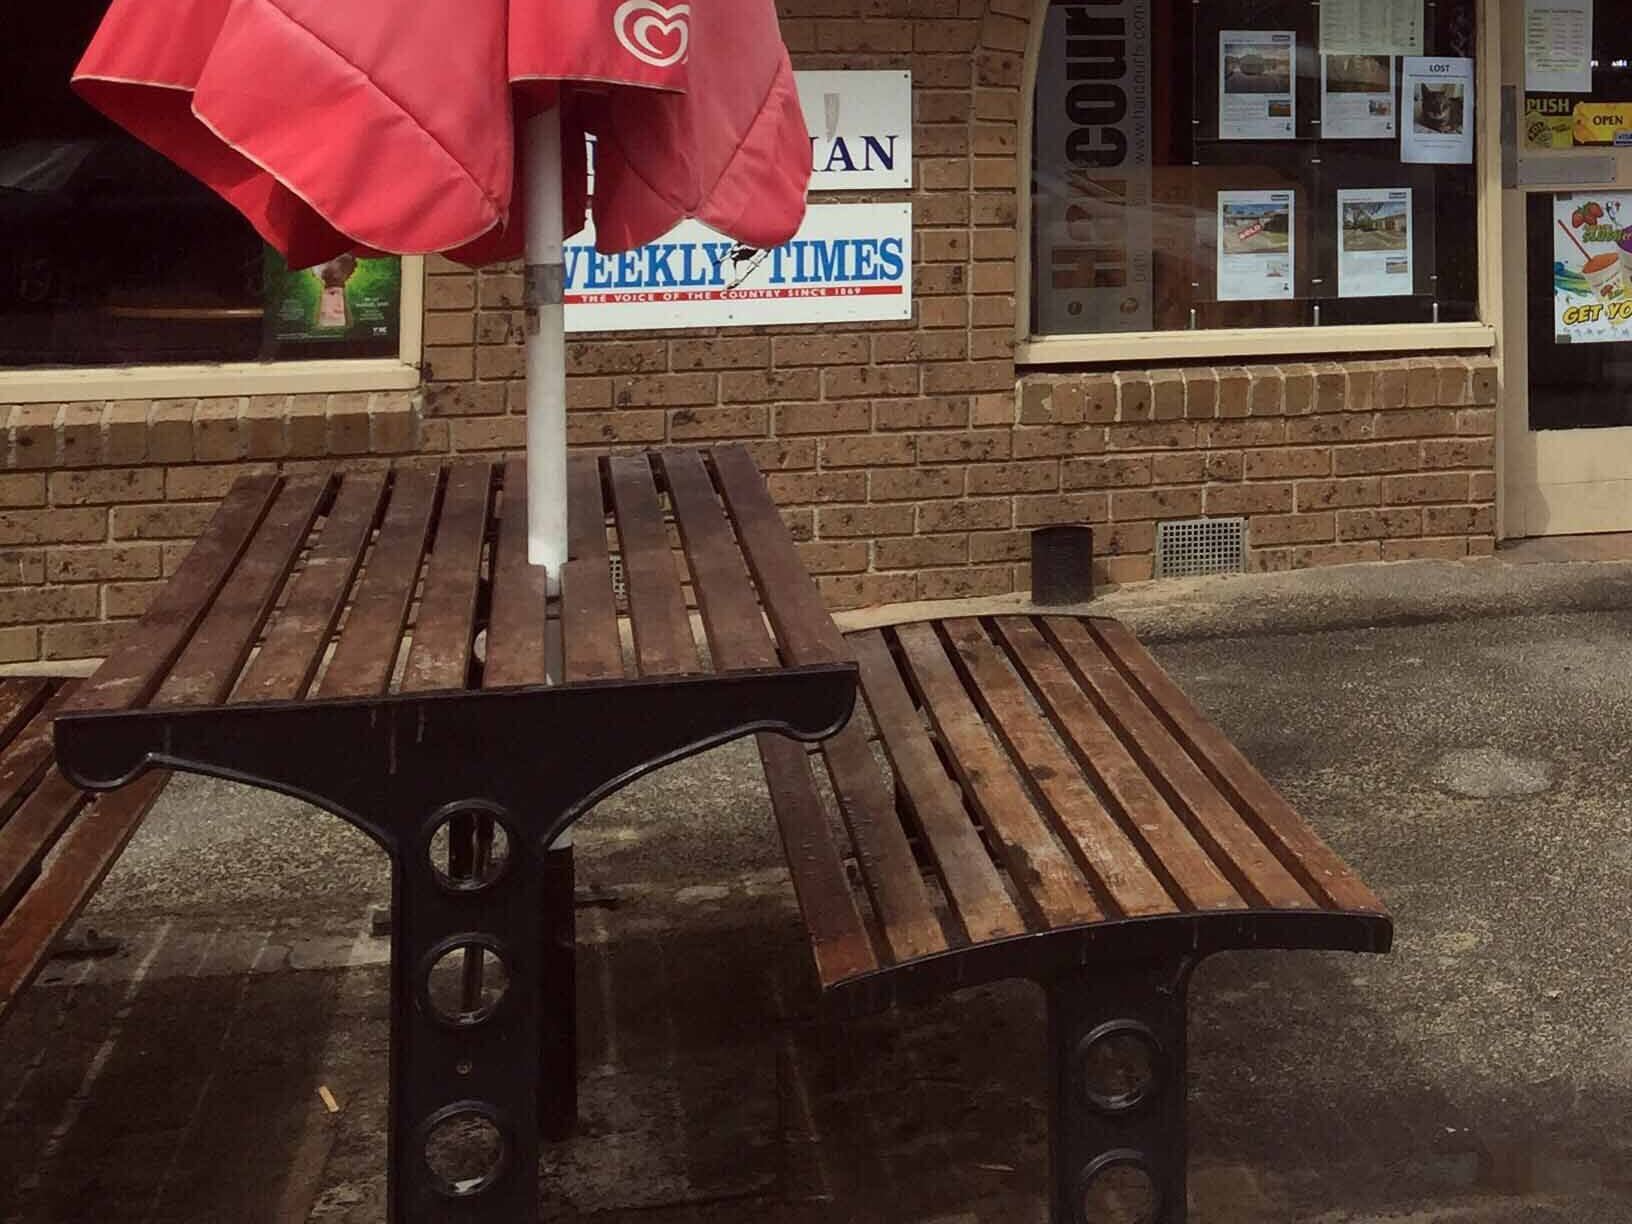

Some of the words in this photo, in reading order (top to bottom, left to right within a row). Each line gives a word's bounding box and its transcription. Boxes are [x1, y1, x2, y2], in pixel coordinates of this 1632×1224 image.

[1429, 64, 1451, 73] LOST
[1526, 98, 1570, 113] PUSH
[1593, 115, 1624, 126] OPEN
[768, 237, 904, 284] TIMES
[581, 295, 606, 304] THE
[614, 293, 654, 302] VOICE
[663, 292, 680, 301] OF
[687, 291, 712, 300] THE
[720, 289, 781, 299] COUNTRY
[787, 287, 827, 297] SINCE
[1562, 304, 1603, 326] GET
